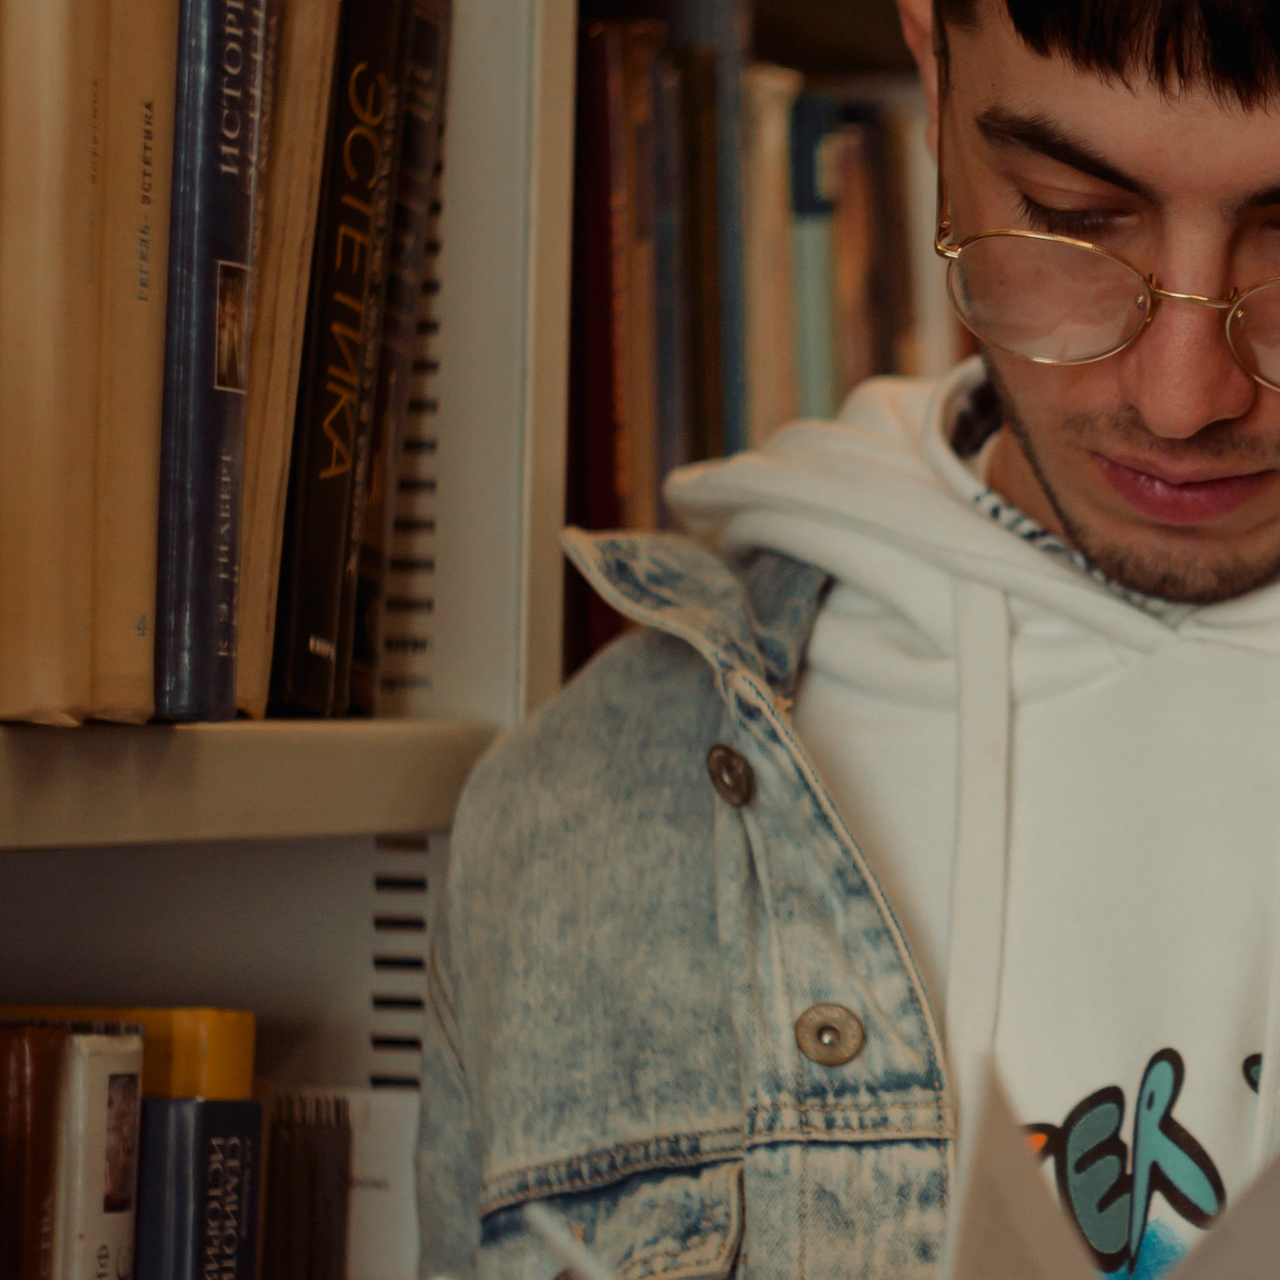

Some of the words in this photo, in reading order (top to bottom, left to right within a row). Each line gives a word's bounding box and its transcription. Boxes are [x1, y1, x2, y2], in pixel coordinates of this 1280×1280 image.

[139, 100, 154, 206] ЭСТЕТИКА
[319, 60, 387, 481] ЭСТЕТИКА
[1024, 1048, 1226, 1276] ER
